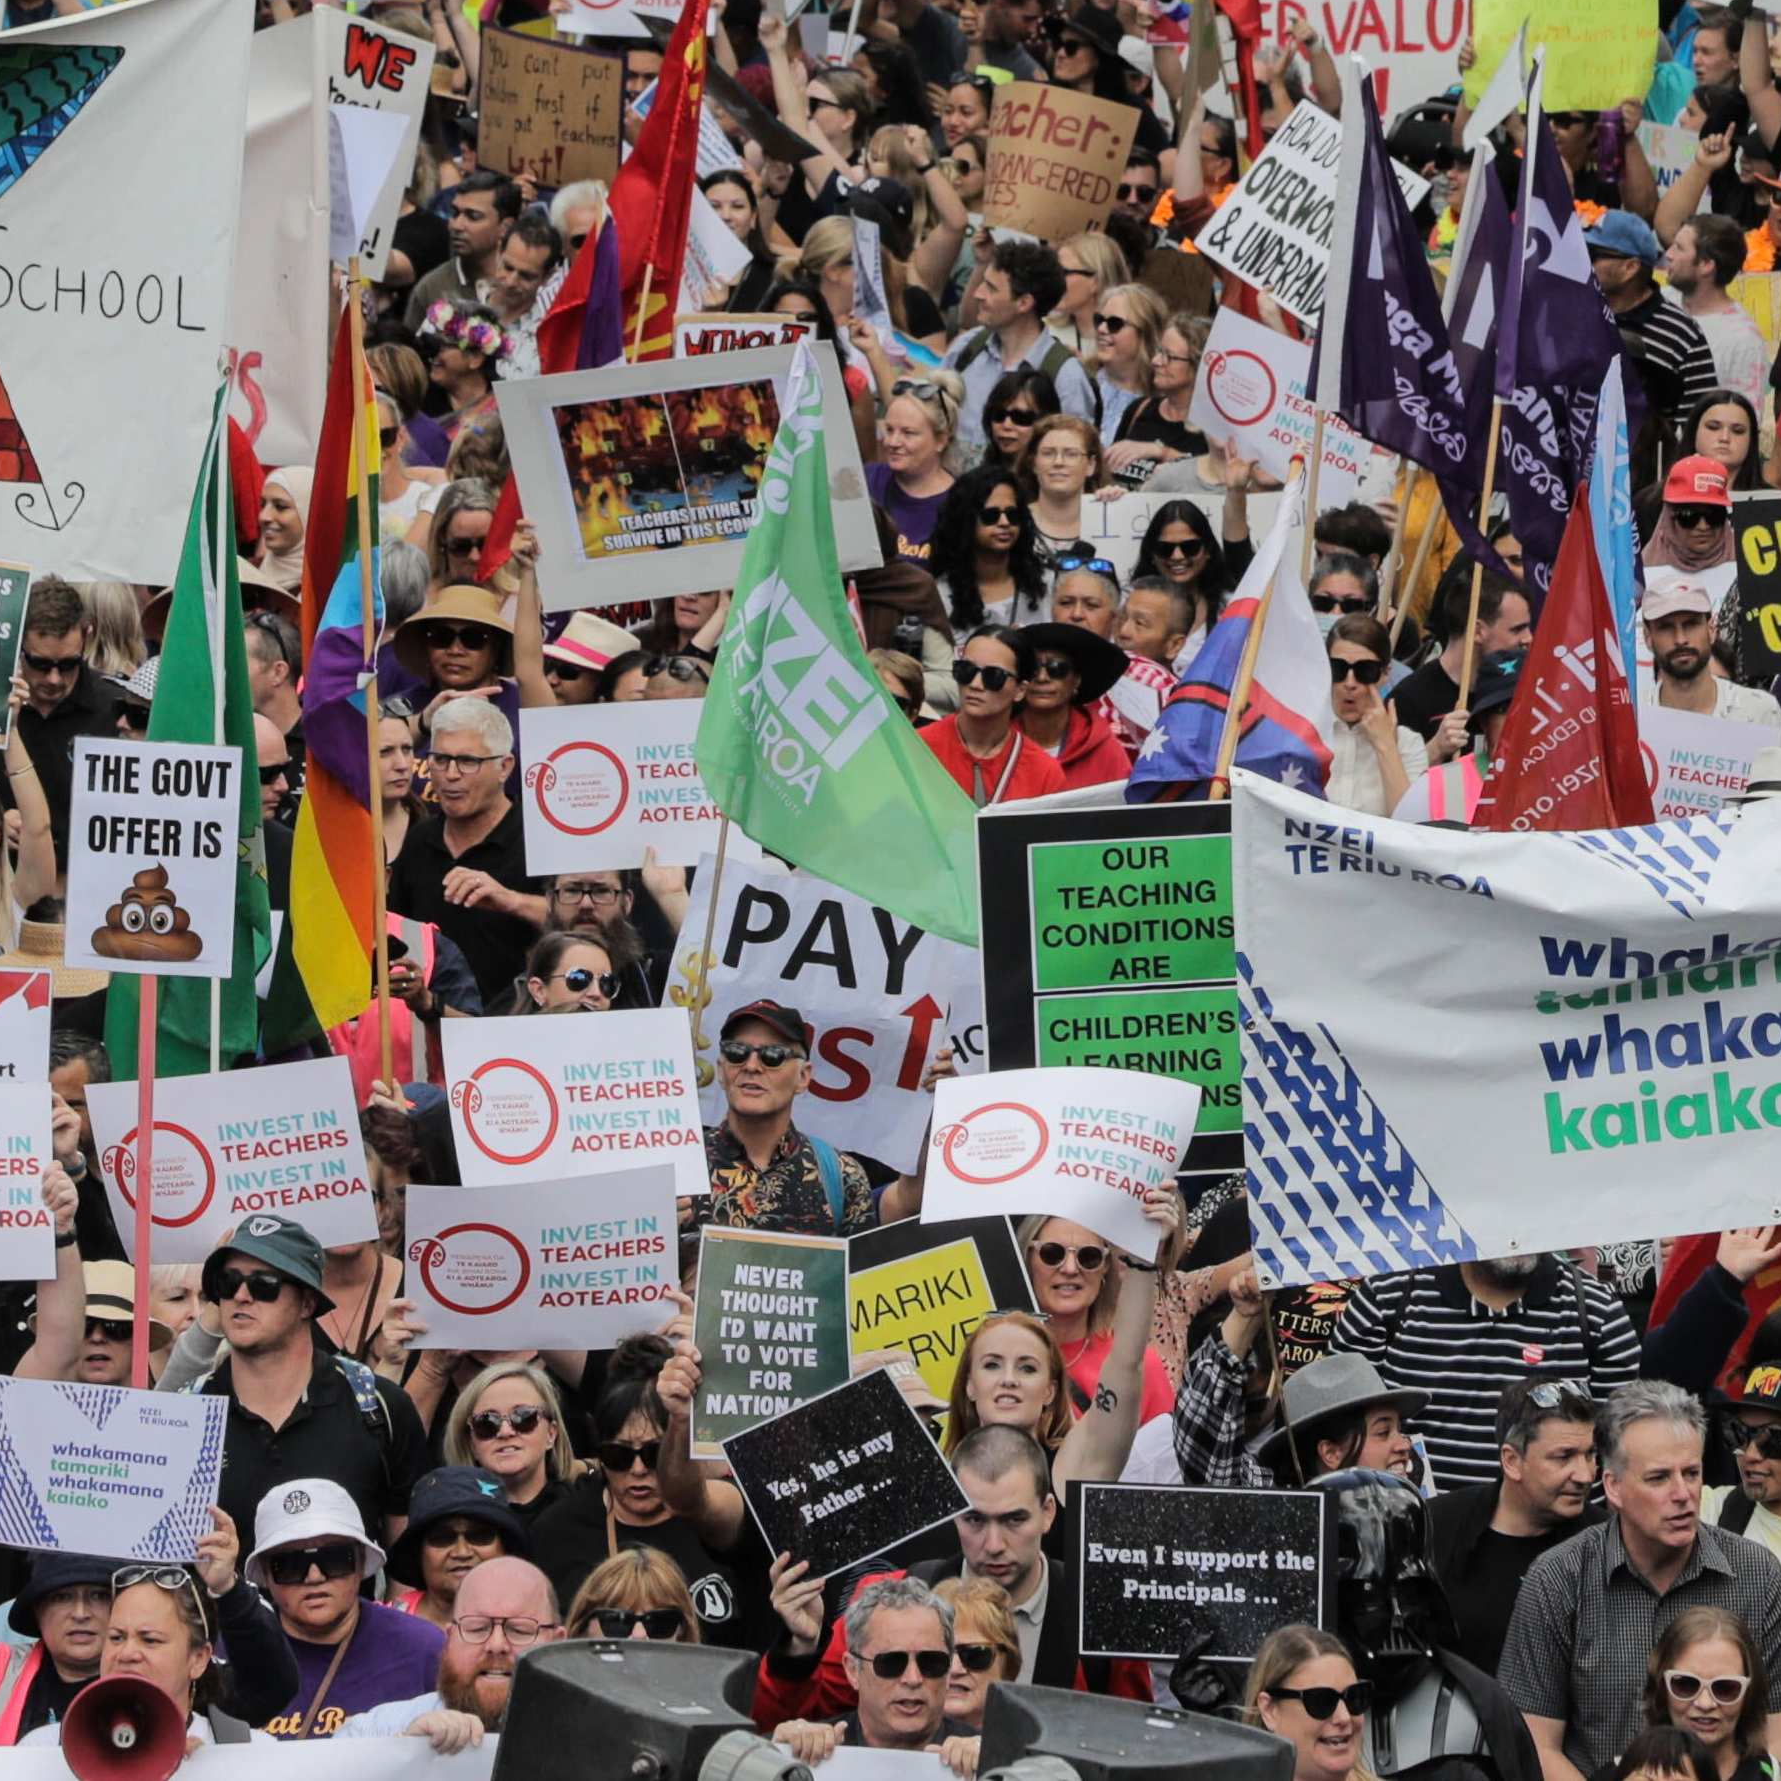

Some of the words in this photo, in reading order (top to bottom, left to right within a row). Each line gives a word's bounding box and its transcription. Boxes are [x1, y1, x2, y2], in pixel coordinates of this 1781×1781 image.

[85, 752, 141, 797] THE
[152, 757, 232, 801] GOVT
[88, 816, 181, 854] OFFER
[193, 821, 223, 859] IS
[1284, 818, 1376, 855] NZEI
[1102, 847, 1169, 870] OUR
[1284, 843, 1330, 874] TE
[1339, 852, 1402, 880] RIU
[1410, 869, 1494, 900] ROA
[1057, 880, 1216, 909] TEACHING
[1042, 916, 1235, 948] CONDITIONS
[1109, 956, 1172, 982] ARE
[7, 1137, 32, 1154] IN
[9, 1188, 32, 1206] IN
[734, 1264, 804, 1291] NEVER
[720, 1289, 819, 1318] THOUGHT
[720, 1317, 746, 1341] I'D
[753, 1318, 818, 1344] WANT
[721, 1343, 748, 1364] TO
[753, 1344, 818, 1367] VOTE
[748, 1369, 792, 1392] FOR
[765, 1475, 809, 1504] Yes,
[809, 1461, 834, 1483] he
[837, 1449, 856, 1471] is
[858, 1430, 896, 1461] my
[800, 1487, 867, 1528] Father
[1088, 1543, 1146, 1569] Even
[1153, 1548, 1166, 1566] I
[1173, 1550, 1268, 1575] support
[1275, 1549, 1316, 1572] the
[1122, 1578, 1247, 1607] Principals
